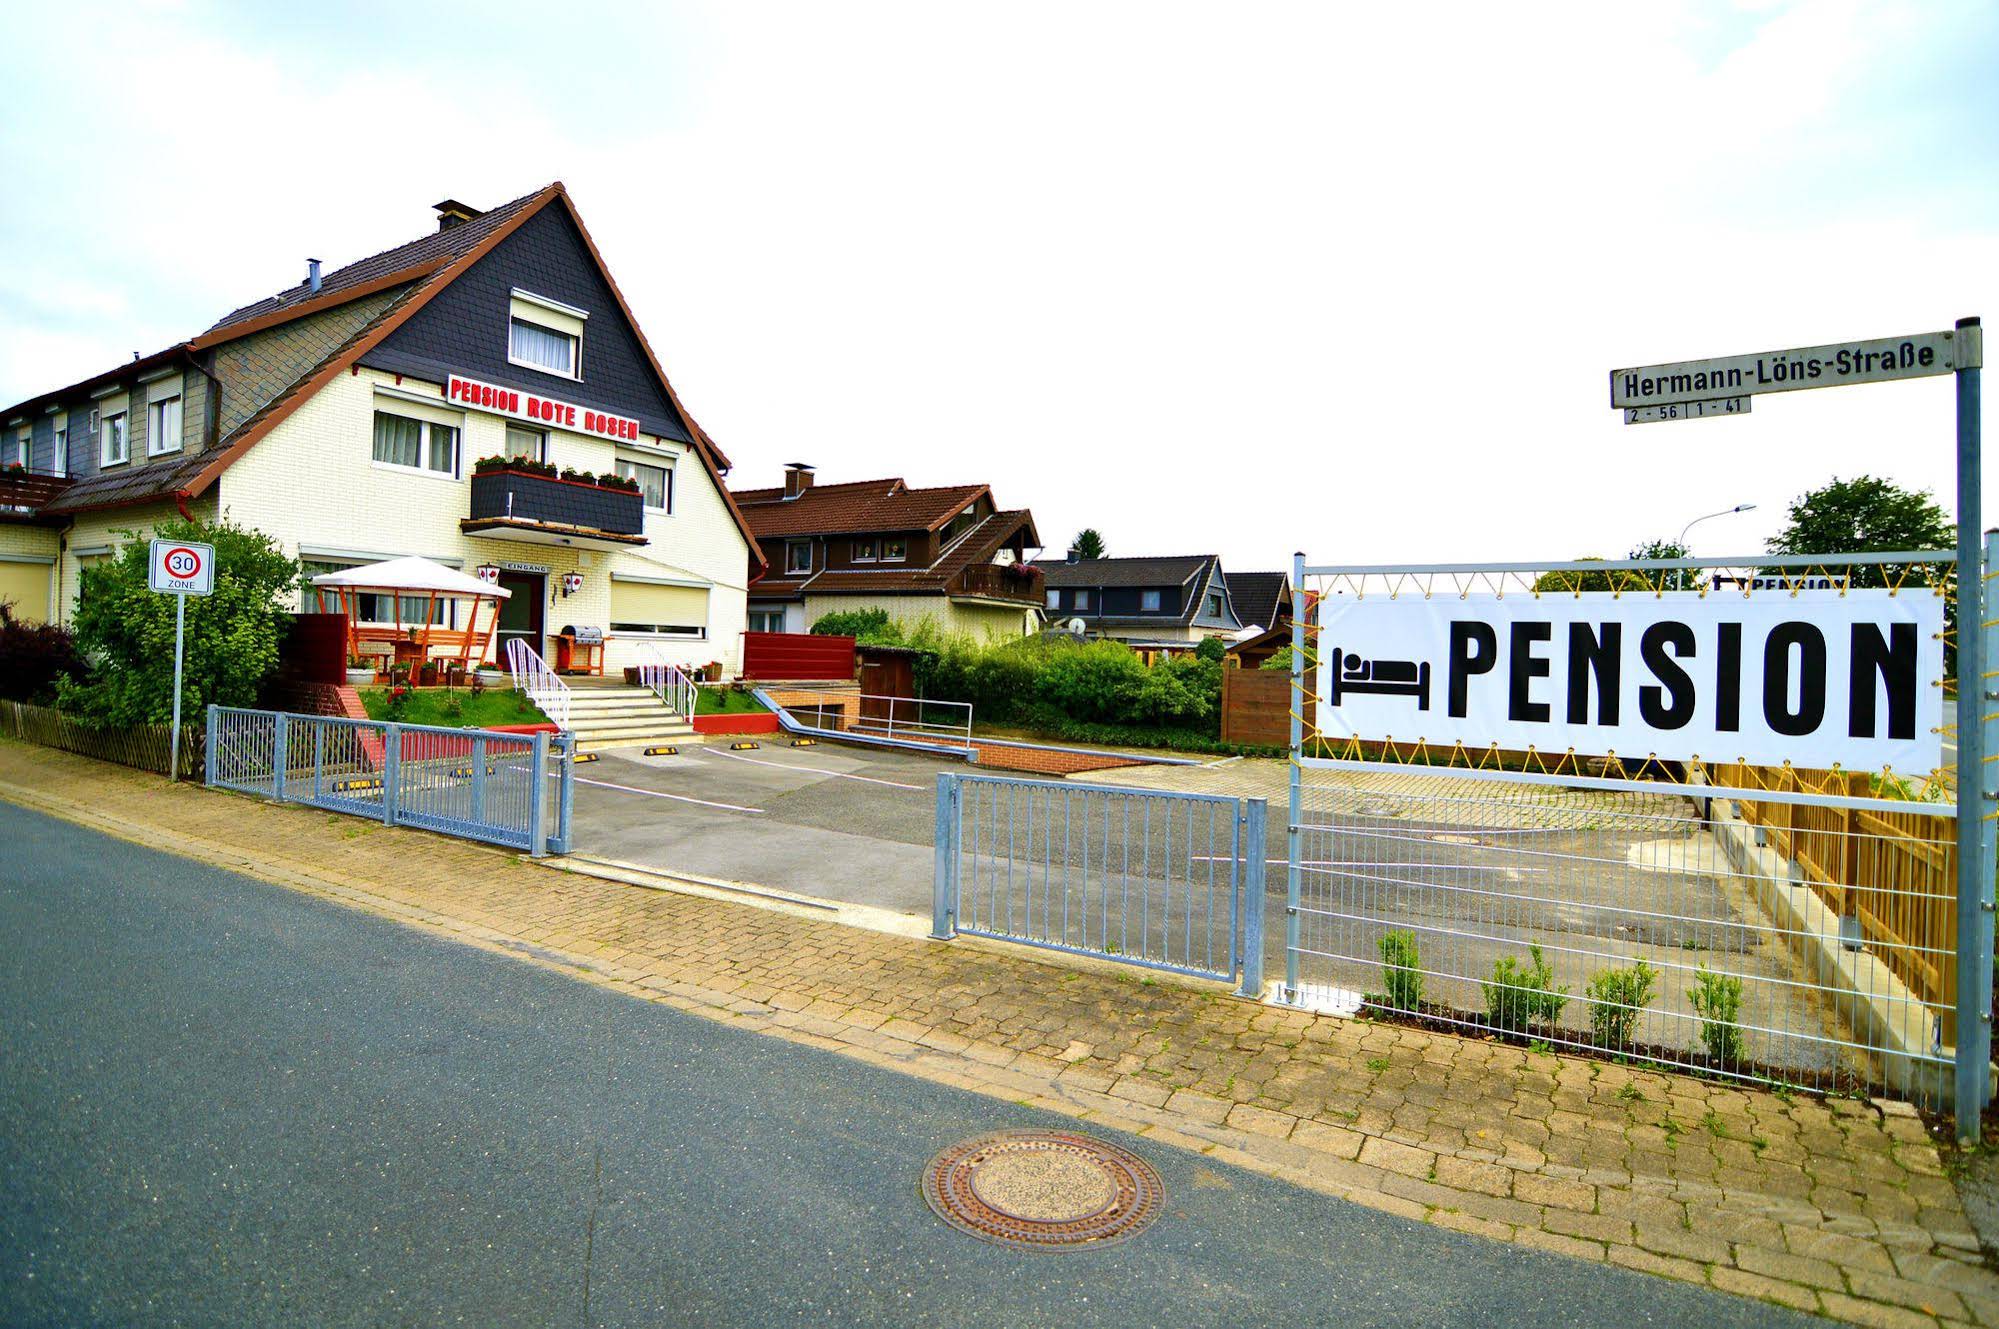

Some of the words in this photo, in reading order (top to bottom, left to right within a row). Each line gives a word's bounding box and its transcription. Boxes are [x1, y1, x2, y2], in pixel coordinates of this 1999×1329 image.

[1625, 342, 1934, 398] Hermann-Löns-Straße
[451, 379, 518, 412] PENSION
[527, 397, 576, 426] ROTE
[584, 411, 638, 441] ROSEN
[1660, 405, 1677, 419] 56
[1725, 398, 1741, 412] 41
[172, 556, 194, 571] 30
[507, 563, 546, 571] EINGANG
[168, 580, 195, 589] ZONE
[1448, 620, 1918, 740] PENSION
